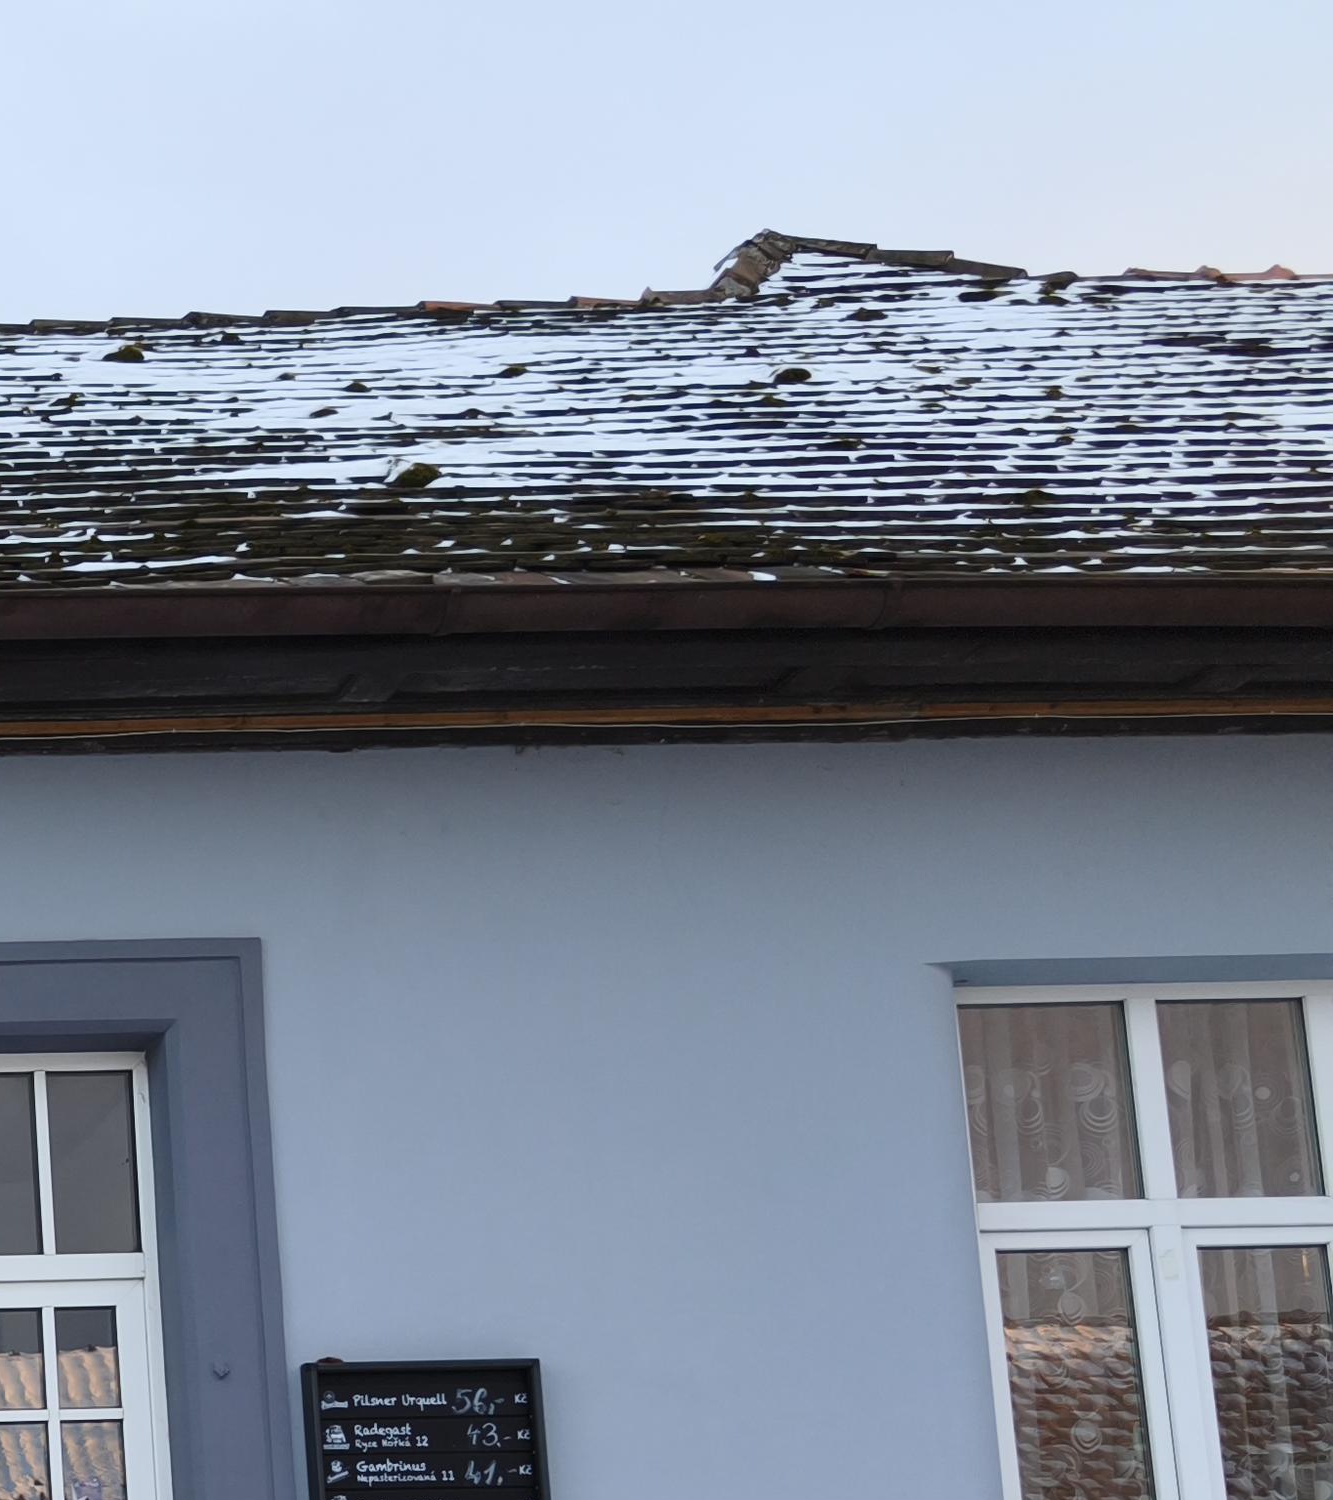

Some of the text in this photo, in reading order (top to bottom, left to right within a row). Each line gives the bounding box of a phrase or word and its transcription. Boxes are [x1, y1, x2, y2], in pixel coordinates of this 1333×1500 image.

[352, 1393, 397, 1406] Pilsner
[402, 1393, 447, 1411] Urquell
[514, 1392, 528, 1404] Kč
[353, 1423, 412, 1440] Radegast
[517, 1429, 531, 1440] Kč
[416, 1435, 429, 1446] 12
[356, 1458, 426, 1473] Gambrinus
[519, 1464, 533, 1475] Kč
[356, 1470, 455, 1487] Nepasterizovaná 11
